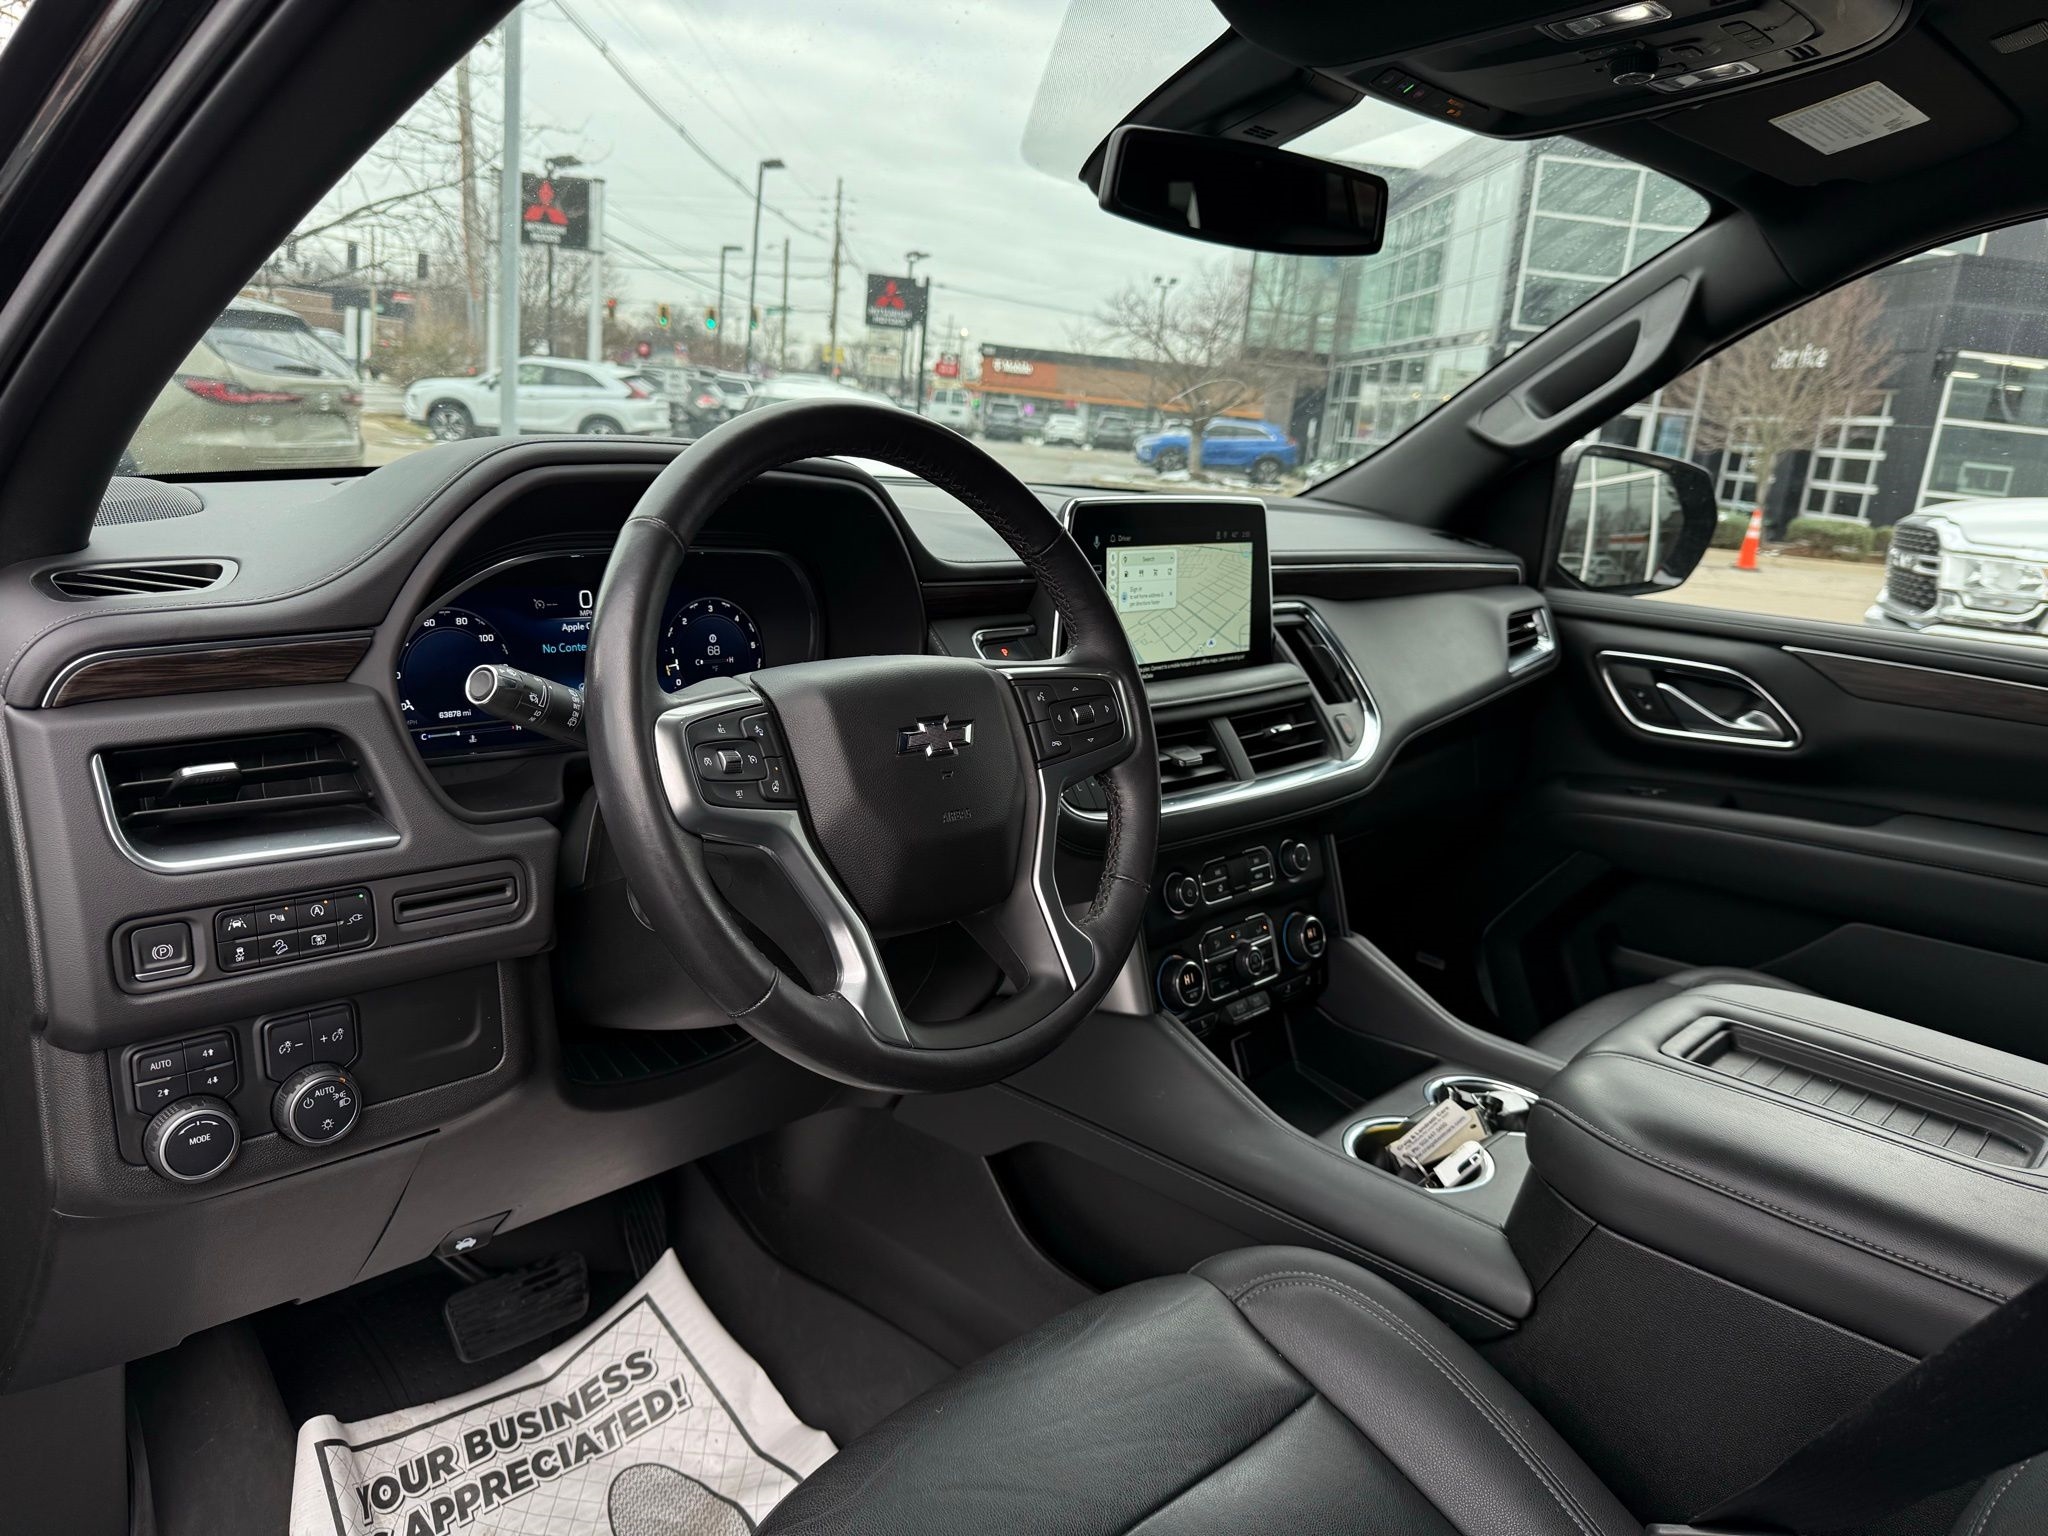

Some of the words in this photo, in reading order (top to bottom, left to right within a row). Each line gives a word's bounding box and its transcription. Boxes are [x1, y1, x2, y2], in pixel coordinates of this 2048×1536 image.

[579, 590, 593, 609] 0
[707, 605, 714, 613] 3
[455, 617, 468, 625] 80
[681, 617, 688, 625] 2
[734, 614, 740, 622] 4
[561, 622, 585, 633] Apple
[478, 634, 495, 642] 100
[542, 643, 557, 654] No
[558, 642, 588, 653] Conte
[707, 645, 720, 656] 68
[675, 678, 682, 686] 0
[438, 710, 462, 719] 63878
[462, 709, 472, 717] mi
[420, 733, 427, 741] C
[235, 954, 245, 962] OFF
[149, 1059, 172, 1071] AUTO
[314, 1085, 336, 1098] AUTO
[188, 1133, 212, 1146] MODE
[354, 1443, 462, 1524] YOUR
[461, 1348, 659, 1468] BUSINESS
[405, 1376, 692, 1536] APPRECIATED!
